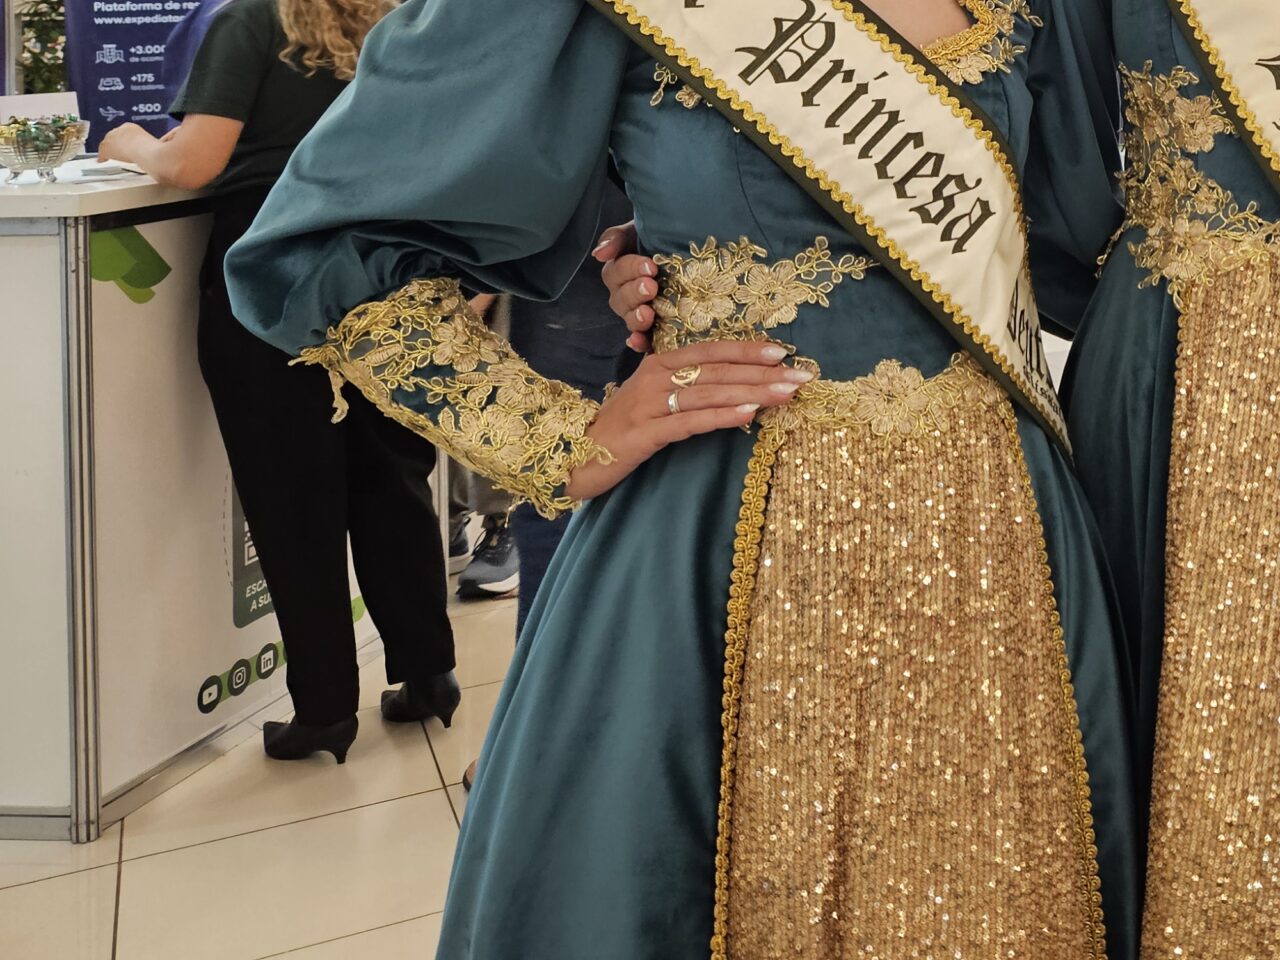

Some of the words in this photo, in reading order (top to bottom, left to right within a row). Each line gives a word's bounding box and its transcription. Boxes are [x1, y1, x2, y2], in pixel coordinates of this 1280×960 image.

[93, 1, 163, 12] Plataforma
[164, 0, 181, 10] de
[131, 73, 155, 83] +175
[132, 103, 161, 113] +500
[250, 600, 257, 612] A
